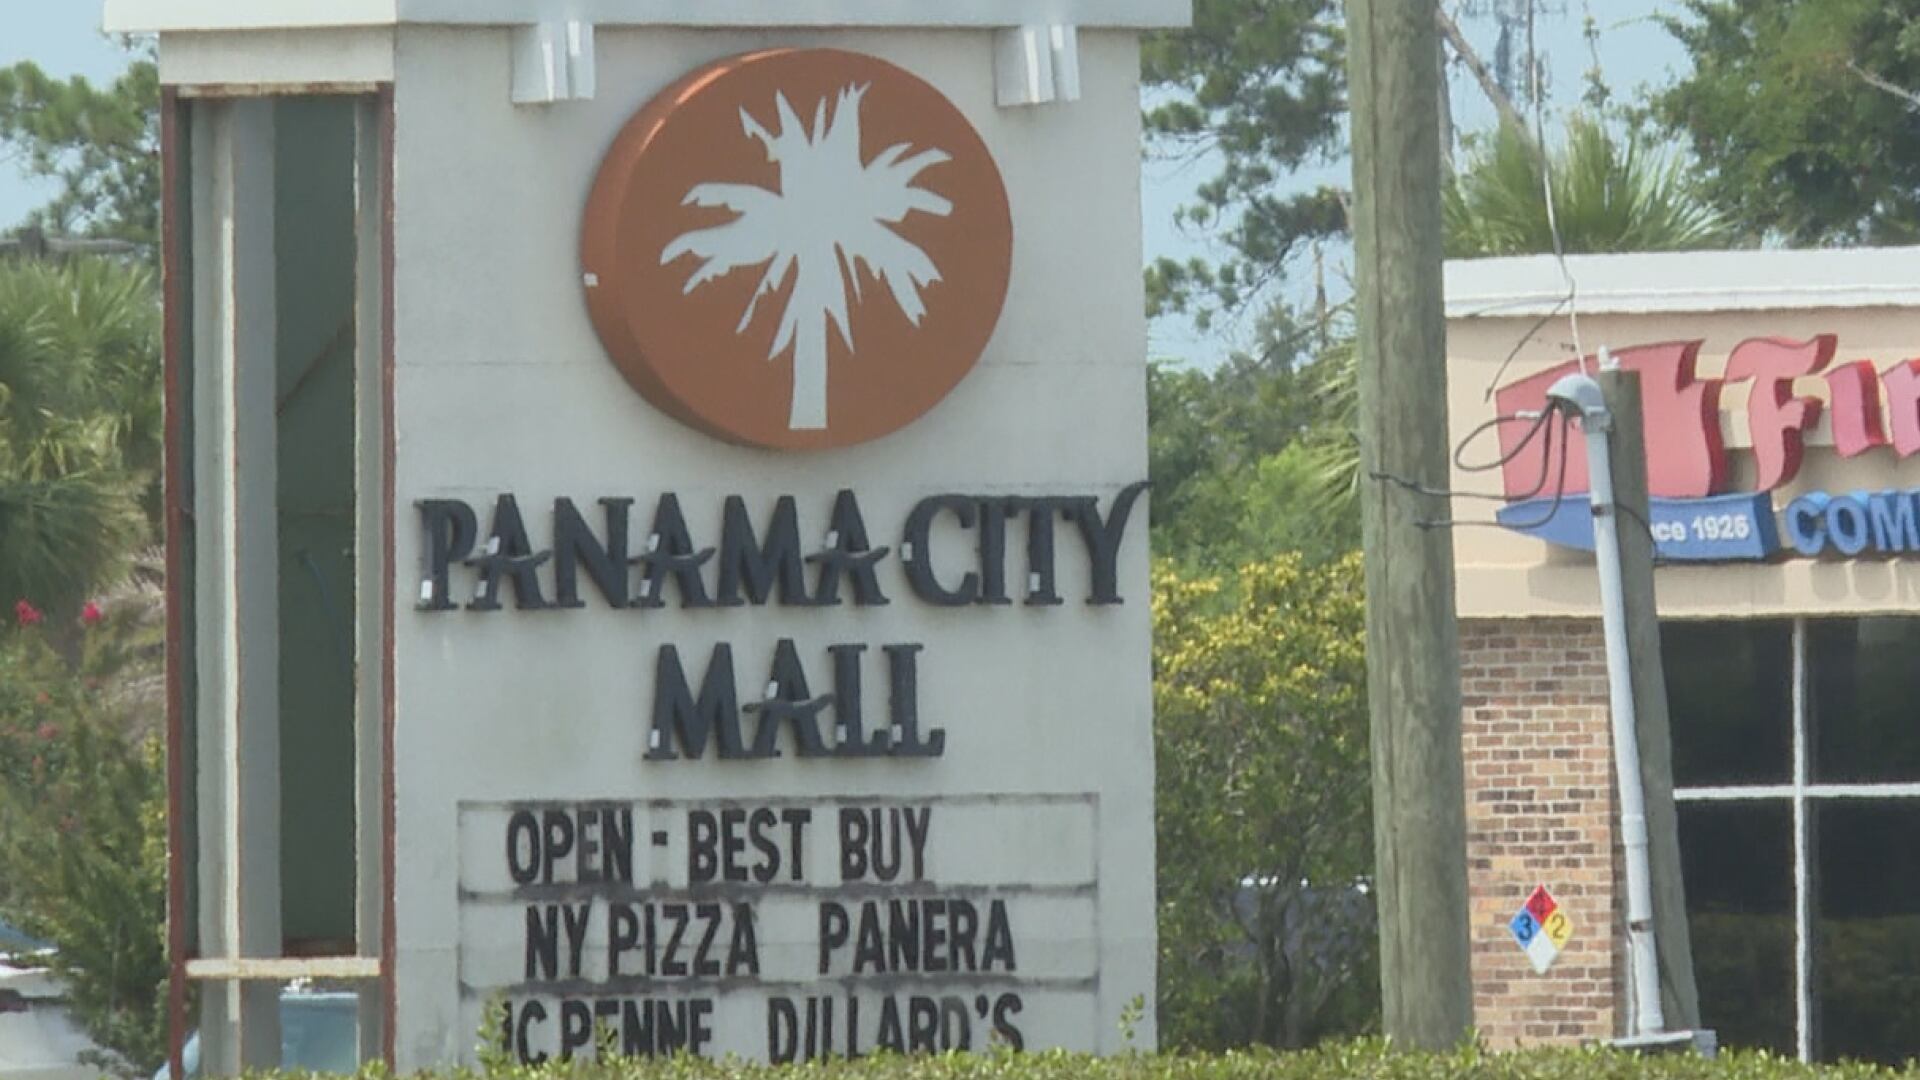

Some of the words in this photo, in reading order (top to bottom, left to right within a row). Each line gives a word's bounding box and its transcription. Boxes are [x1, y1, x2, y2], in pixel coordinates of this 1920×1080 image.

[413, 488, 891, 611] PANAMA
[901, 481, 1155, 607] CITY
[1692, 514, 1749, 540] 1926
[643, 638, 946, 761] MALL
[506, 807, 633, 886] OPEN
[688, 806, 812, 884] BEST
[838, 806, 932, 883] BUY
[525, 903, 591, 979] NY
[607, 902, 760, 978] PIZZA
[818, 899, 1017, 976] PANERA
[1517, 912, 1533, 942] 3
[1552, 913, 1566, 939] 2
[767, 992, 1025, 1066] DILLARD'S
